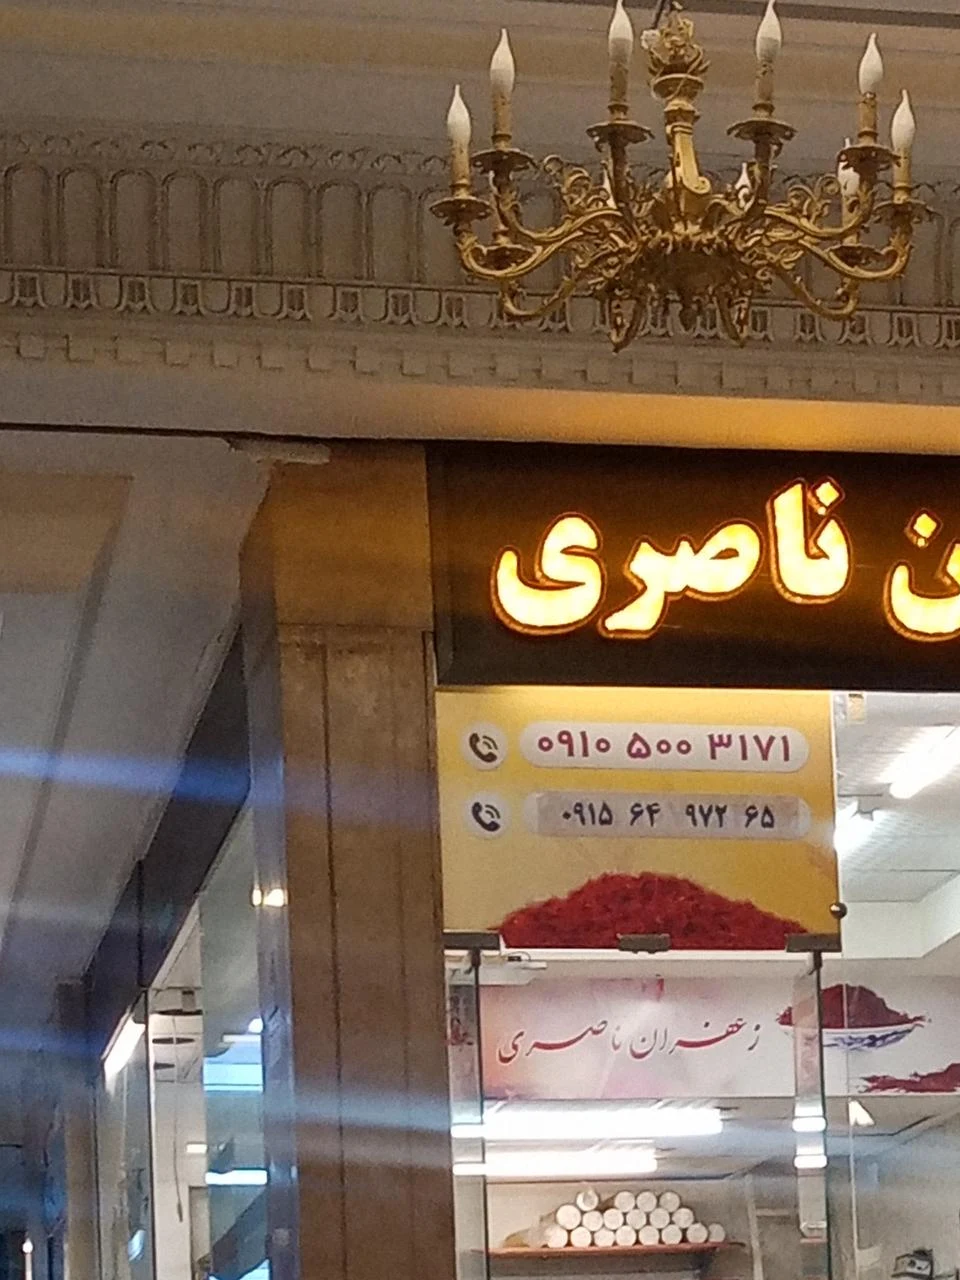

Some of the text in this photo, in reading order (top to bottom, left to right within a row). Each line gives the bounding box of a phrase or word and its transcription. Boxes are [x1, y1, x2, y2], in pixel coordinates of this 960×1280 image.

[492, 477, 851, 640] ناصری
[538, 730, 790, 762] ۰۹۱۰ ۵۰۰ ۳۱۷۱
[498, 1016, 761, 1064] زعفران ناصری
